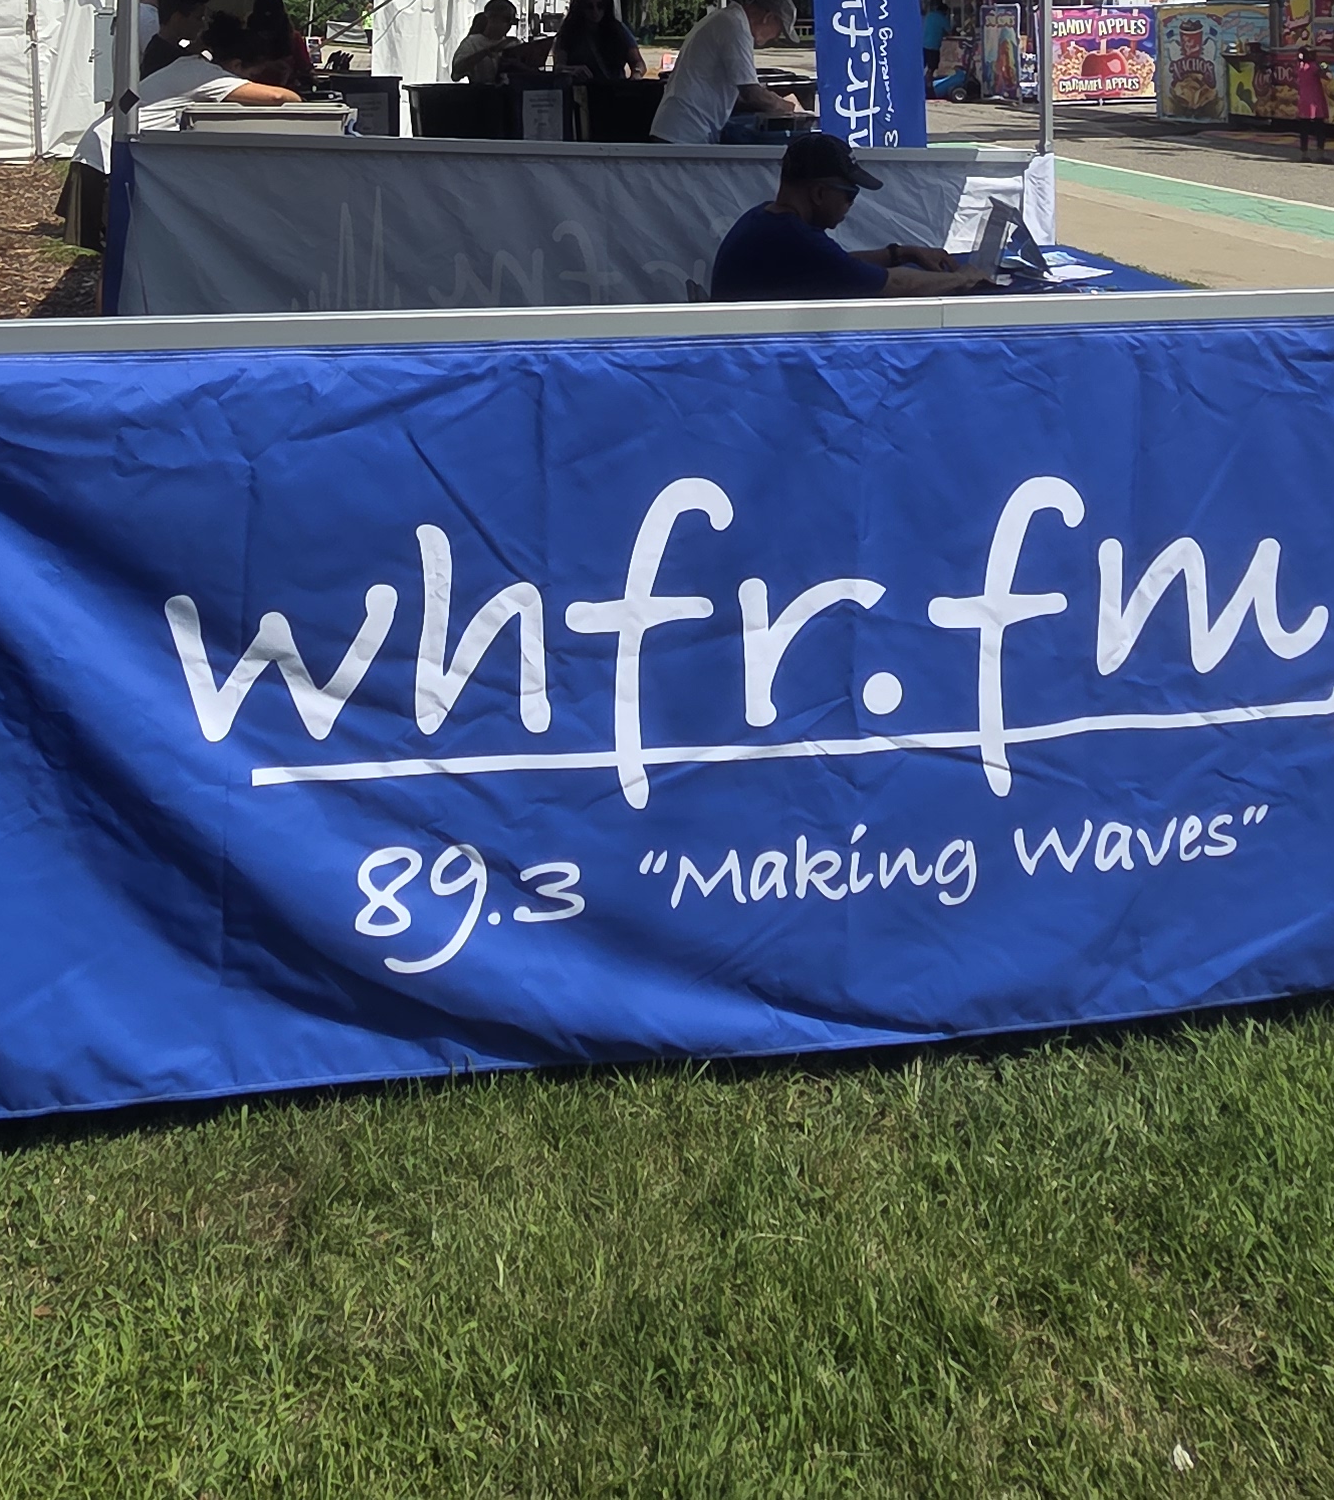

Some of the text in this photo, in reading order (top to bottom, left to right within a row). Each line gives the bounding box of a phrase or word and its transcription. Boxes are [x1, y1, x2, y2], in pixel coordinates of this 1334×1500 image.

[1052, 16, 1146, 38] CANDY APPLES
[1059, 77, 1140, 92] CARAMEL APPLES
[164, 475, 1330, 809] whfr.fm
[353, 843, 587, 973] 89.3
